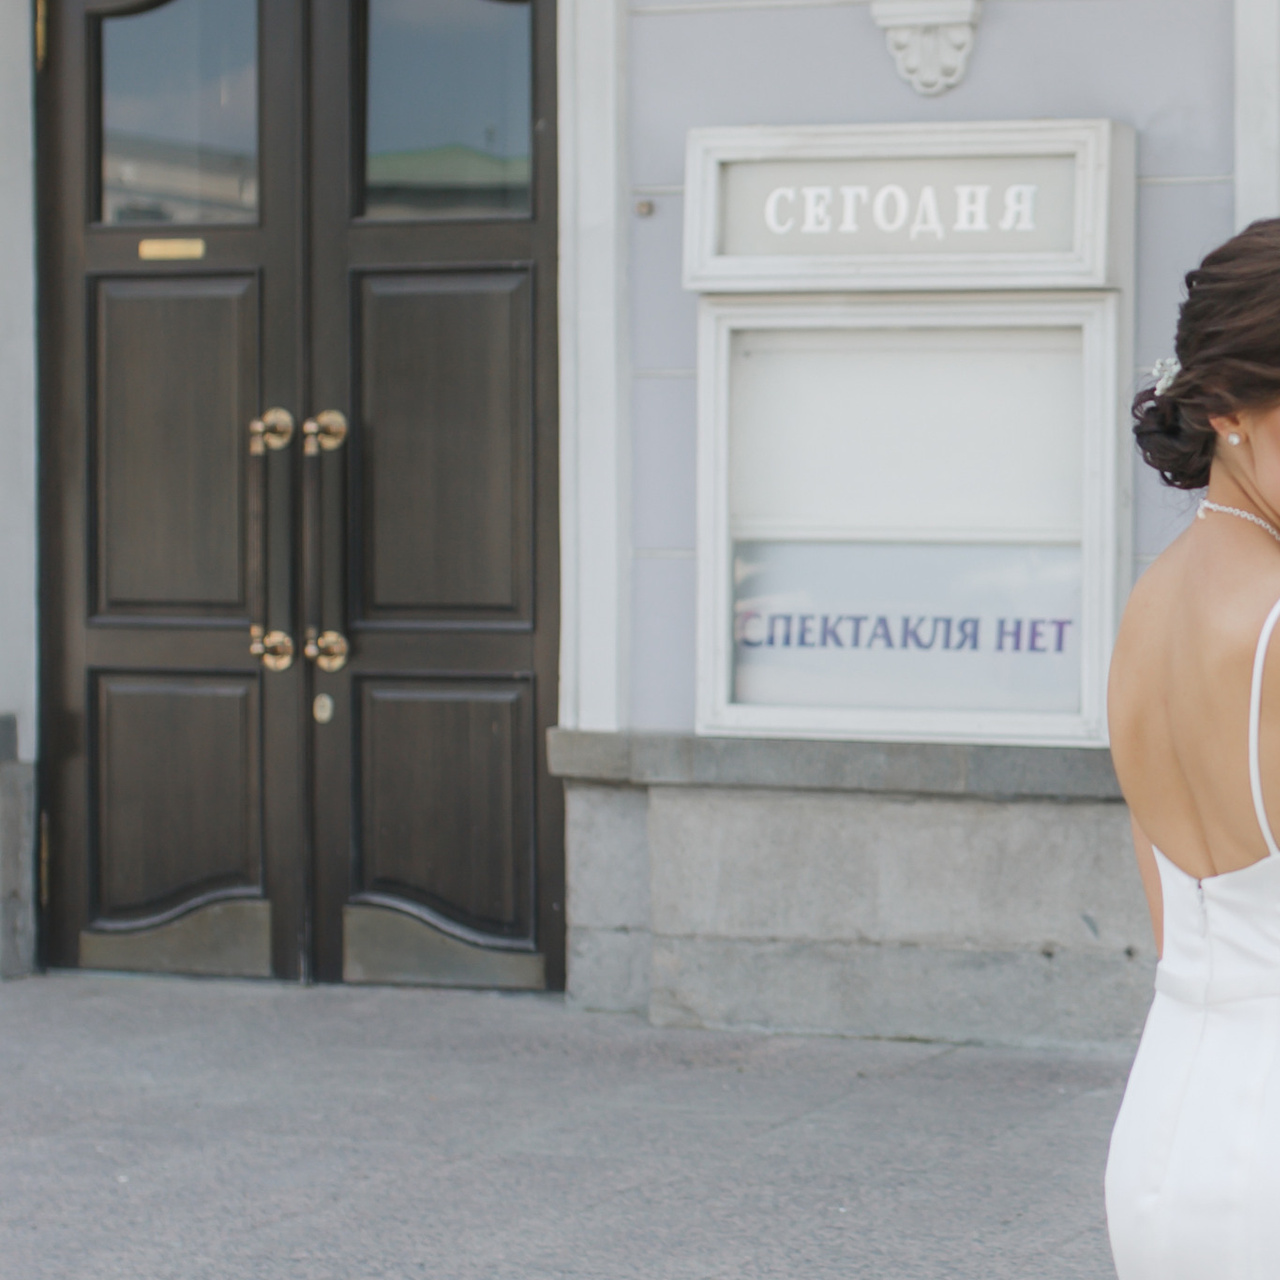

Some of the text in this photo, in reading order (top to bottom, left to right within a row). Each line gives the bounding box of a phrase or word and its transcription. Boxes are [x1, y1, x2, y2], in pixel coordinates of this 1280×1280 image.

[764, 183, 1038, 240] СЕГОДНЯ
[740, 611, 1072, 652] СПЕКТАКЛЯ НЕТ
